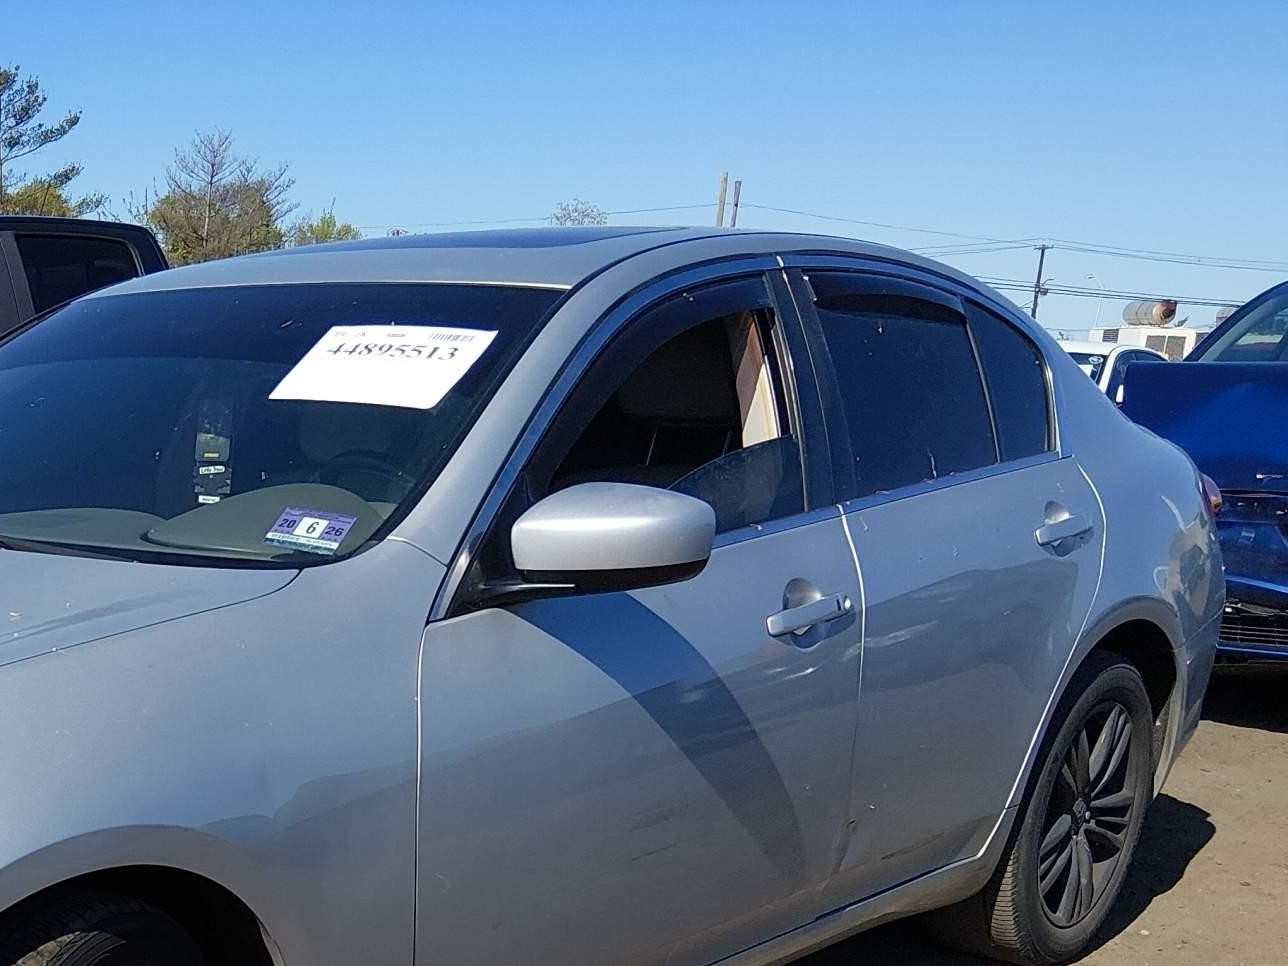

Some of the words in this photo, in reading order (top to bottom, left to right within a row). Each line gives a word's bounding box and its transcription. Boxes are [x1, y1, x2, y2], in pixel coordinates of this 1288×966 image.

[327, 342, 460, 361] 44895513
[278, 518, 297, 529] 20
[306, 521, 320, 535] 6
[325, 526, 345, 537] 26
